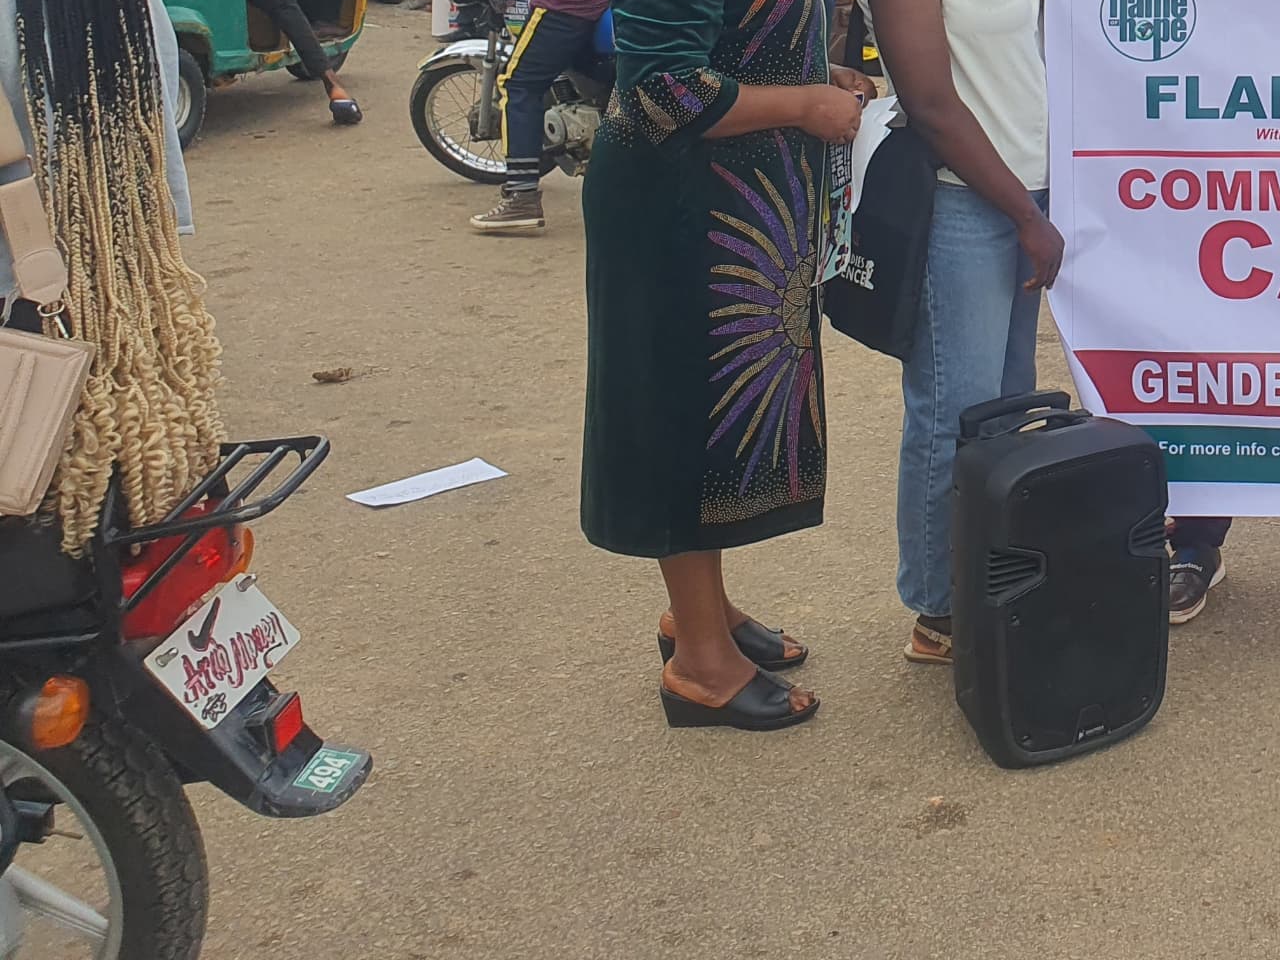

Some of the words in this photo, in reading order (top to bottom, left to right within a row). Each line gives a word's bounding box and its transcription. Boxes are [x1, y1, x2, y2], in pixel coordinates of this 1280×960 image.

[1159, 440, 1185, 455] For
[1190, 443, 1231, 456] more
[1236, 441, 1267, 457] info
[307, 756, 351, 788] 494
